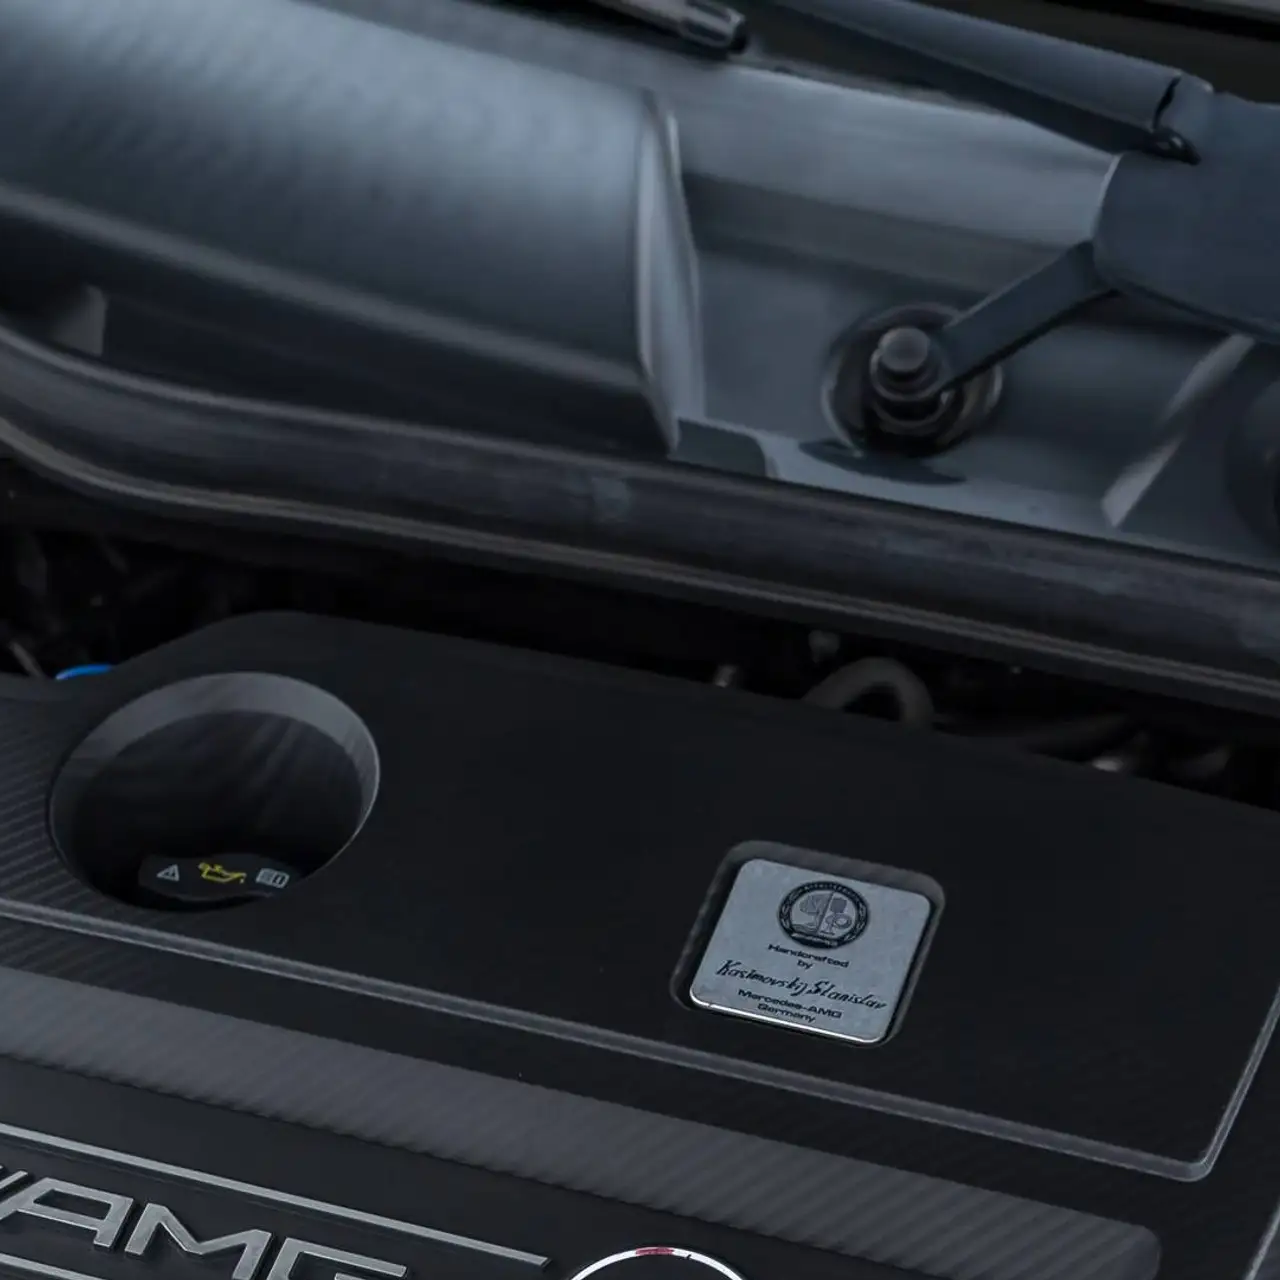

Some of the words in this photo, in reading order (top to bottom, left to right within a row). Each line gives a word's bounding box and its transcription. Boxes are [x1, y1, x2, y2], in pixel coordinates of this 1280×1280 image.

[768, 943, 850, 969] Handcrafted
[797, 959, 814, 971] by
[738, 988, 842, 1020] Mercedes-AMG
[757, 1003, 816, 1024] Germany
